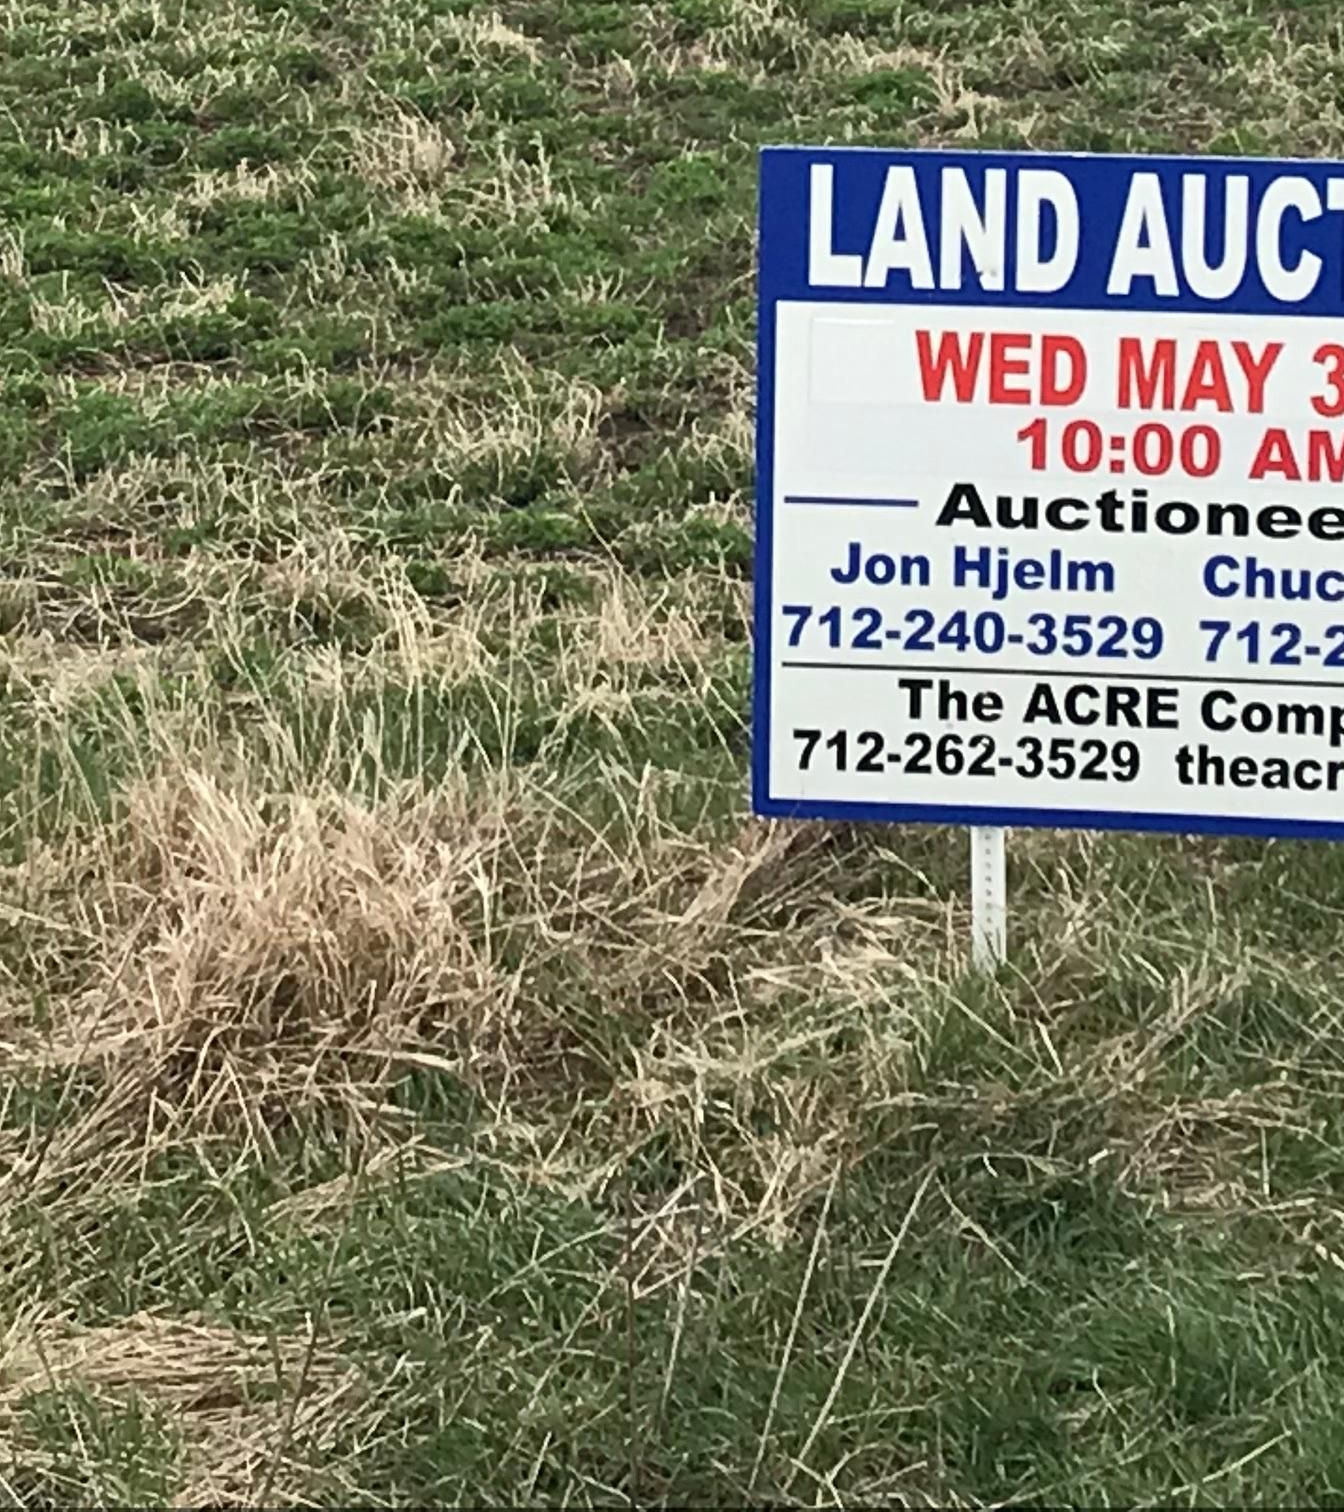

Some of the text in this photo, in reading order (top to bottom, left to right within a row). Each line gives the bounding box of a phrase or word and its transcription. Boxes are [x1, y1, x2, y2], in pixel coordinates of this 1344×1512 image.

[808, 163, 1080, 293] LAND
[915, 330, 1087, 406] WED
[1118, 337, 1283, 414] MAY
[1017, 418, 1221, 478] 10:00
[830, 542, 1115, 601] Jon Hjelm
[782, 605, 1164, 660] 712-240-3529
[898, 678, 1004, 723] The
[1022, 683, 1179, 729] ACRE
[793, 729, 1140, 783] 712-262-3529
